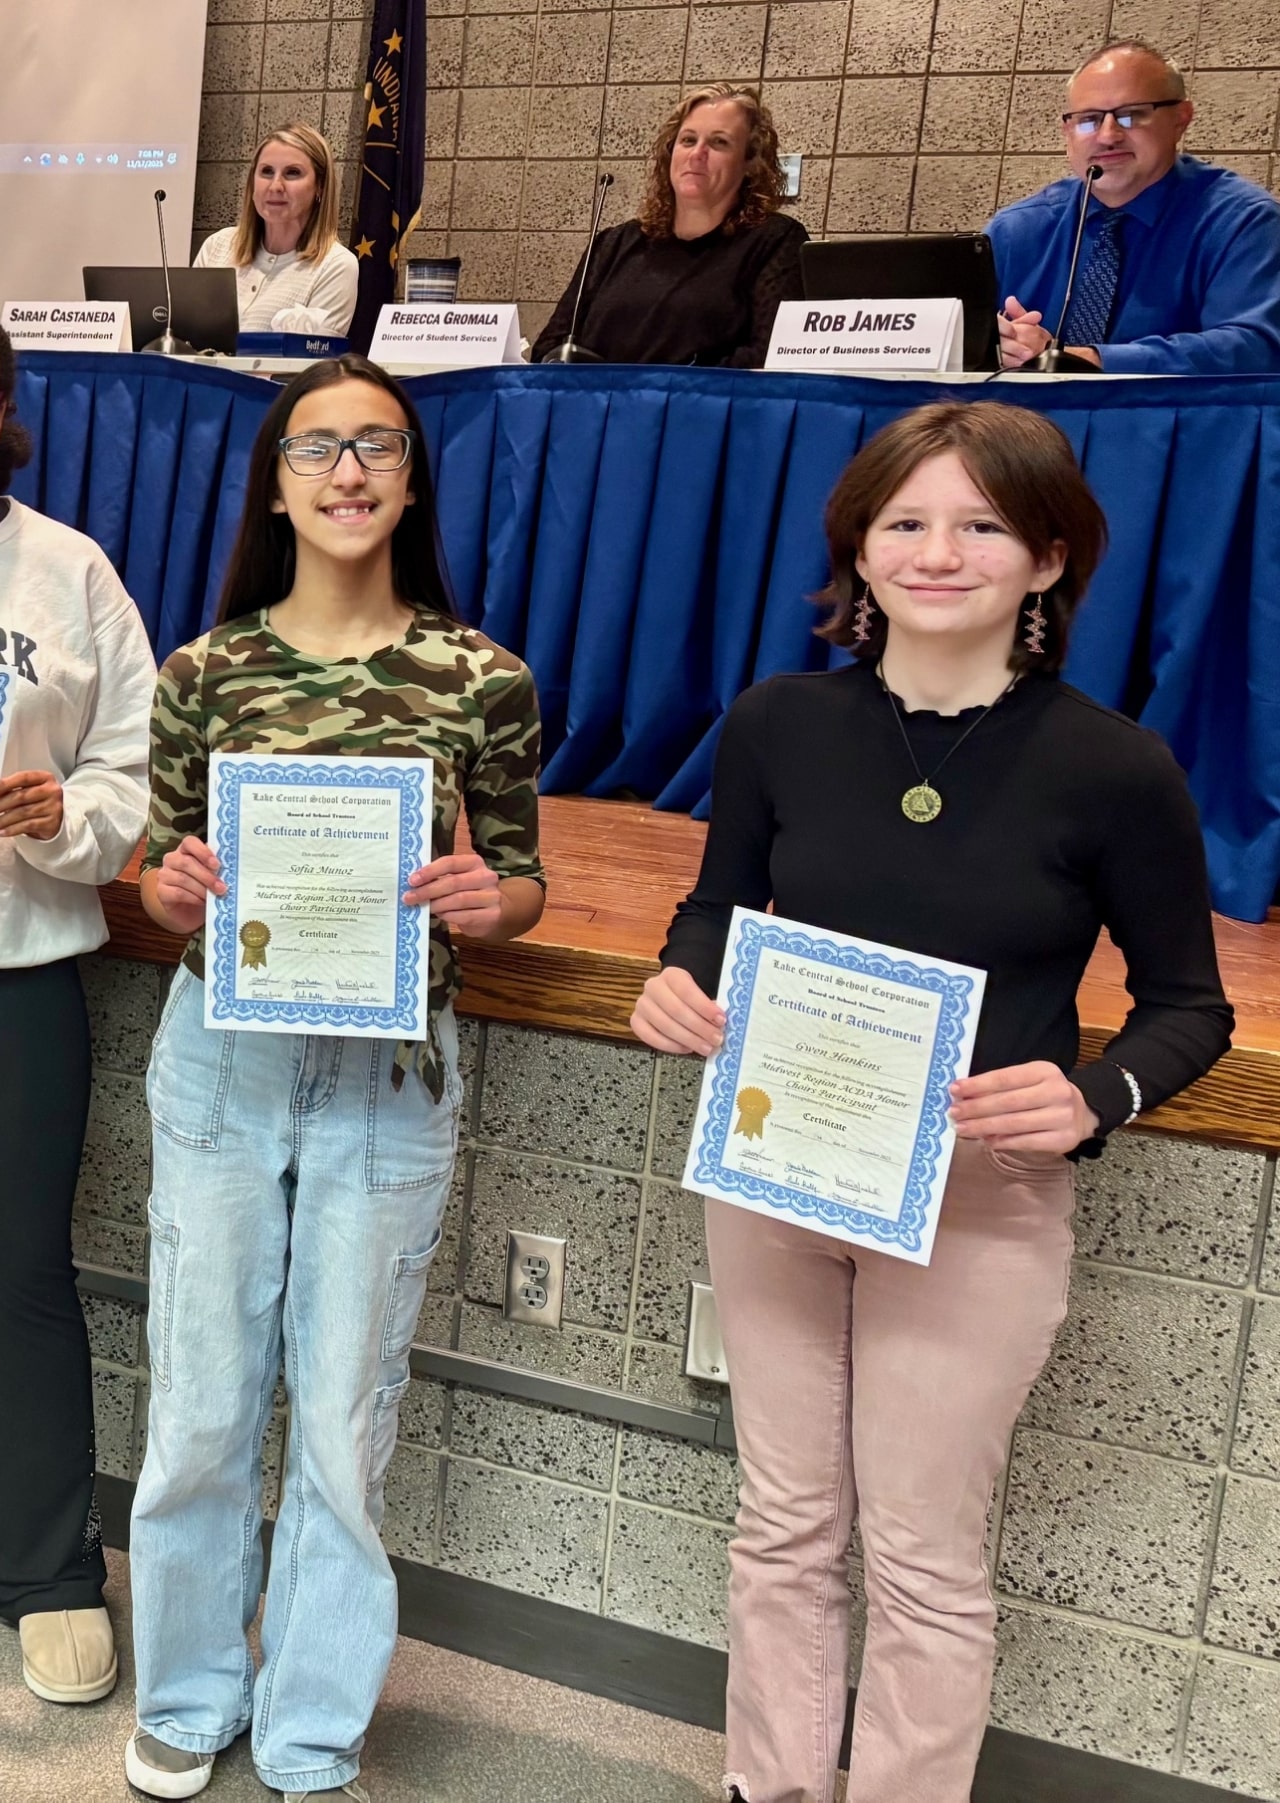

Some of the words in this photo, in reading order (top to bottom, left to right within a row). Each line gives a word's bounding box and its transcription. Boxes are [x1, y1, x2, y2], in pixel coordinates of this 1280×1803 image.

[10, 308, 47, 321] SARAH
[50, 309, 115, 323] CASTANEDA
[391, 312, 440, 325] REBECCA
[444, 312, 498, 325] GROMALA
[803, 311, 846, 332] ROB
[849, 311, 916, 332] JAMES
[47, 331, 113, 340] Superintendent
[460, 334, 497, 342] Services
[777, 347, 817, 355] Director
[820, 346, 831, 354] of
[833, 346, 880, 354] Business
[883, 346, 931, 354] Services
[252, 793, 273, 802] Lake
[276, 794, 307, 803] Central
[310, 795, 338, 804] School
[341, 796, 391, 806] Corporation
[253, 825, 306, 837] Certificate
[310, 827, 319, 838] of
[323, 827, 389, 840] Achievement
[288, 864, 314, 875] Sofia
[317, 866, 354, 875] Munoz
[254, 892, 292, 900] Midwest
[294, 893, 323, 903] Region
[325, 895, 356, 903] ACDA
[358, 896, 388, 904] Honor
[309, 904, 360, 915] Participant
[299, 930, 338, 938] Certificate
[773, 959, 796, 974] Lake
[799, 966, 832, 983] Central
[835, 977, 868, 993] School
[872, 987, 930, 1009] Corporation
[808, 988, 827, 998] Board
[837, 996, 857, 1006] School
[768, 994, 827, 1019] Certificate
[831, 1013, 842, 1023] of
[845, 1014, 922, 1044] Achievement
[796, 1041, 828, 1057] Gwen
[828, 1051, 882, 1072] Hankins
[759, 1061, 801, 1078] Midwest
[803, 1073, 837, 1088] Region
[838, 1084, 874, 1099] ACDA
[874, 1094, 911, 1109] Honor
[786, 1080, 816, 1094] Choirs
[818, 1088, 877, 1112] Participant
[803, 1112, 847, 1132] Certificate
